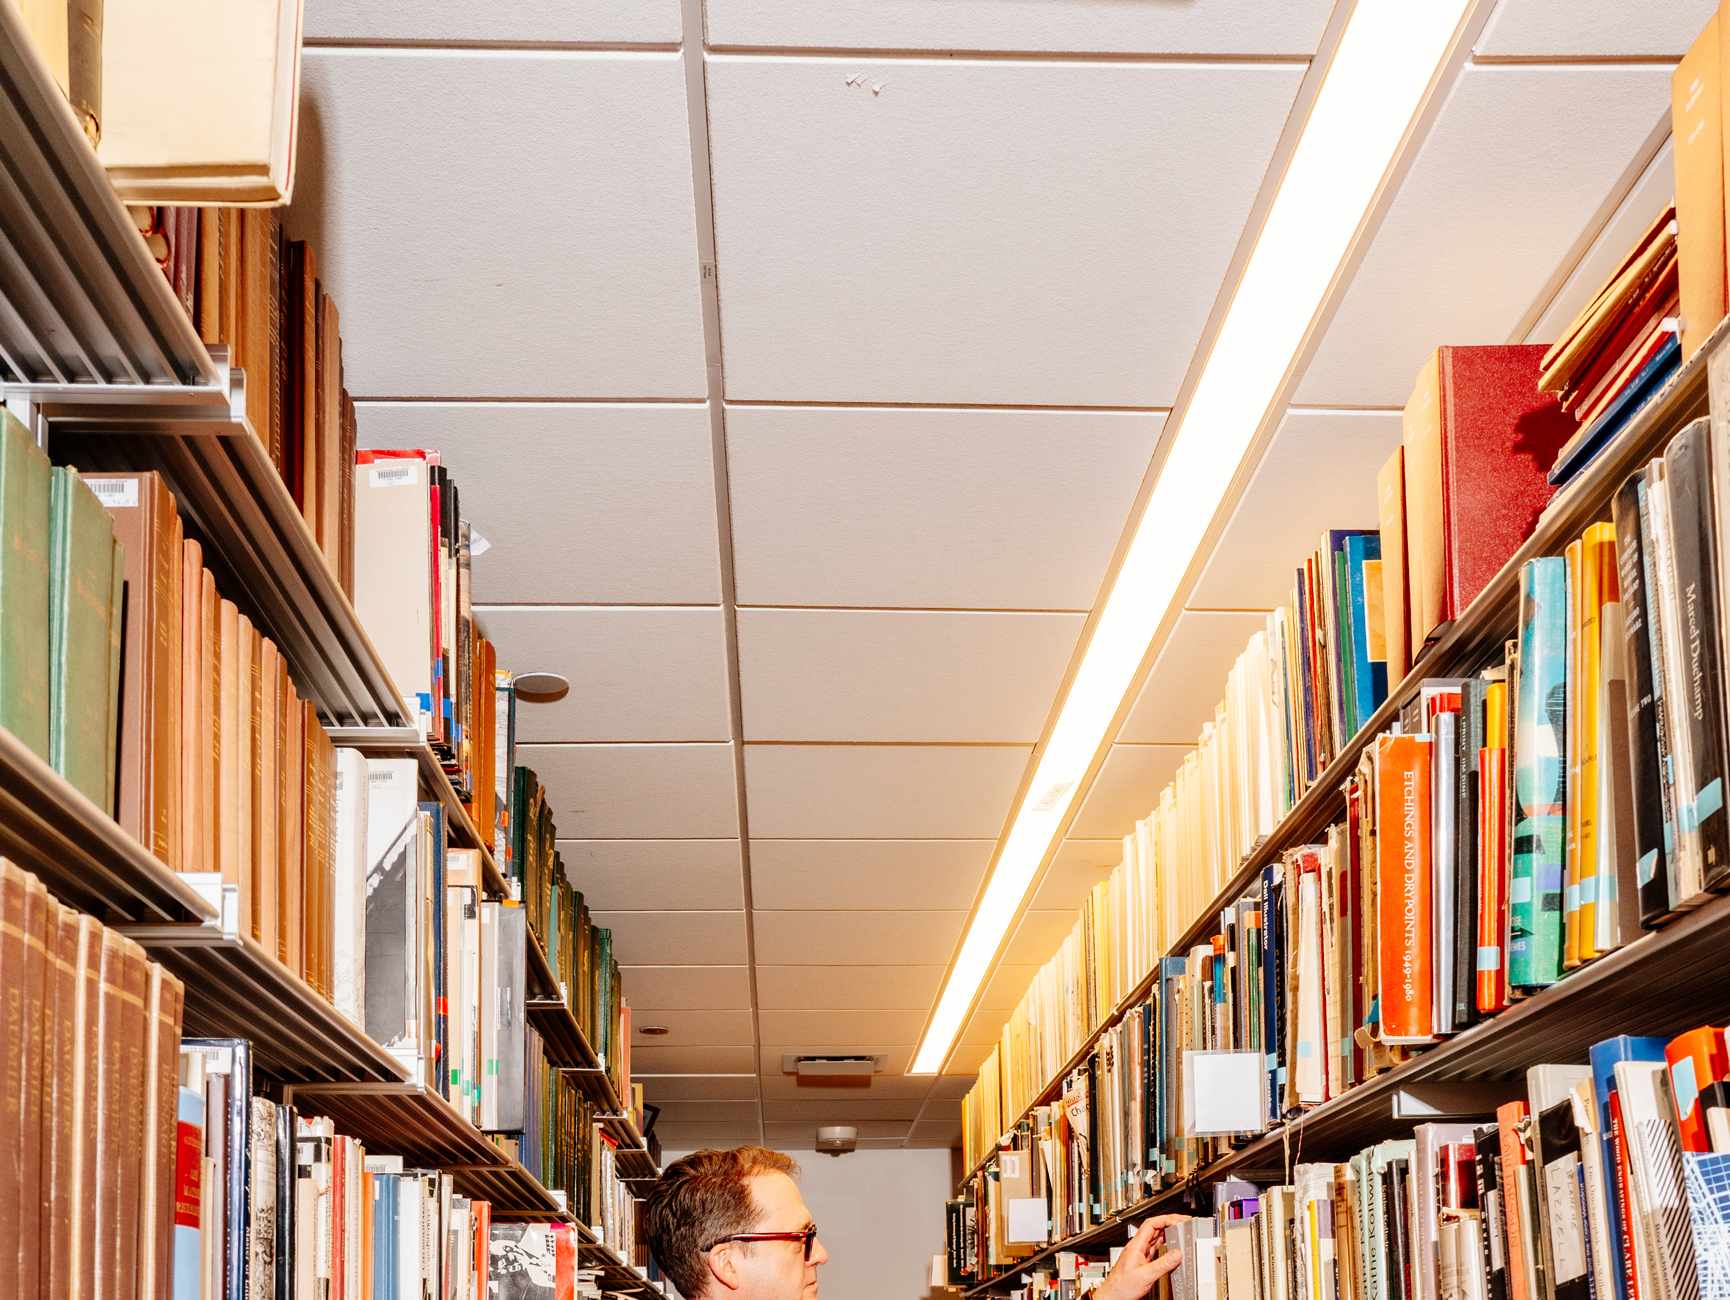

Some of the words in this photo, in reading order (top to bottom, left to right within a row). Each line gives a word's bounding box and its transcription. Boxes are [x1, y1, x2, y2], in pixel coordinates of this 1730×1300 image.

[1685, 582, 1700, 640] Marcel
[1690, 639, 1704, 720] Duchamp
[1404, 770, 1414, 836] ETCHINGS
[1403, 840, 1414, 868] AND
[1403, 872, 1414, 946] DRYPOINTS
[1403, 950, 1414, 1002] 1949-1980
[7, 987, 20, 1112] DAUMIER
[30, 998, 41, 1122] DAUMIER
[44, 1009, 52, 1127] DAUMIER
[64, 1019, 72, 1135] DAUMIER
[112, 1041, 121, 1149] DAUMIER
[129, 1046, 139, 1154] DAUMIER
[162, 1063, 170, 1163] BESNARD
[1614, 1138, 1622, 1162] WOOD
[1506, 1174, 1518, 1248] LARSSON
[1551, 1168, 1565, 1270] LAZZELL
[1566, 1170, 1577, 1229] BLANCHE
[1590, 1184, 1601, 1245] Druckgraphik
[1616, 1164, 1627, 1220] ENGRAVINGS
[1621, 1234, 1633, 1278] CLARE
[1654, 1224, 1663, 1244] Roy
